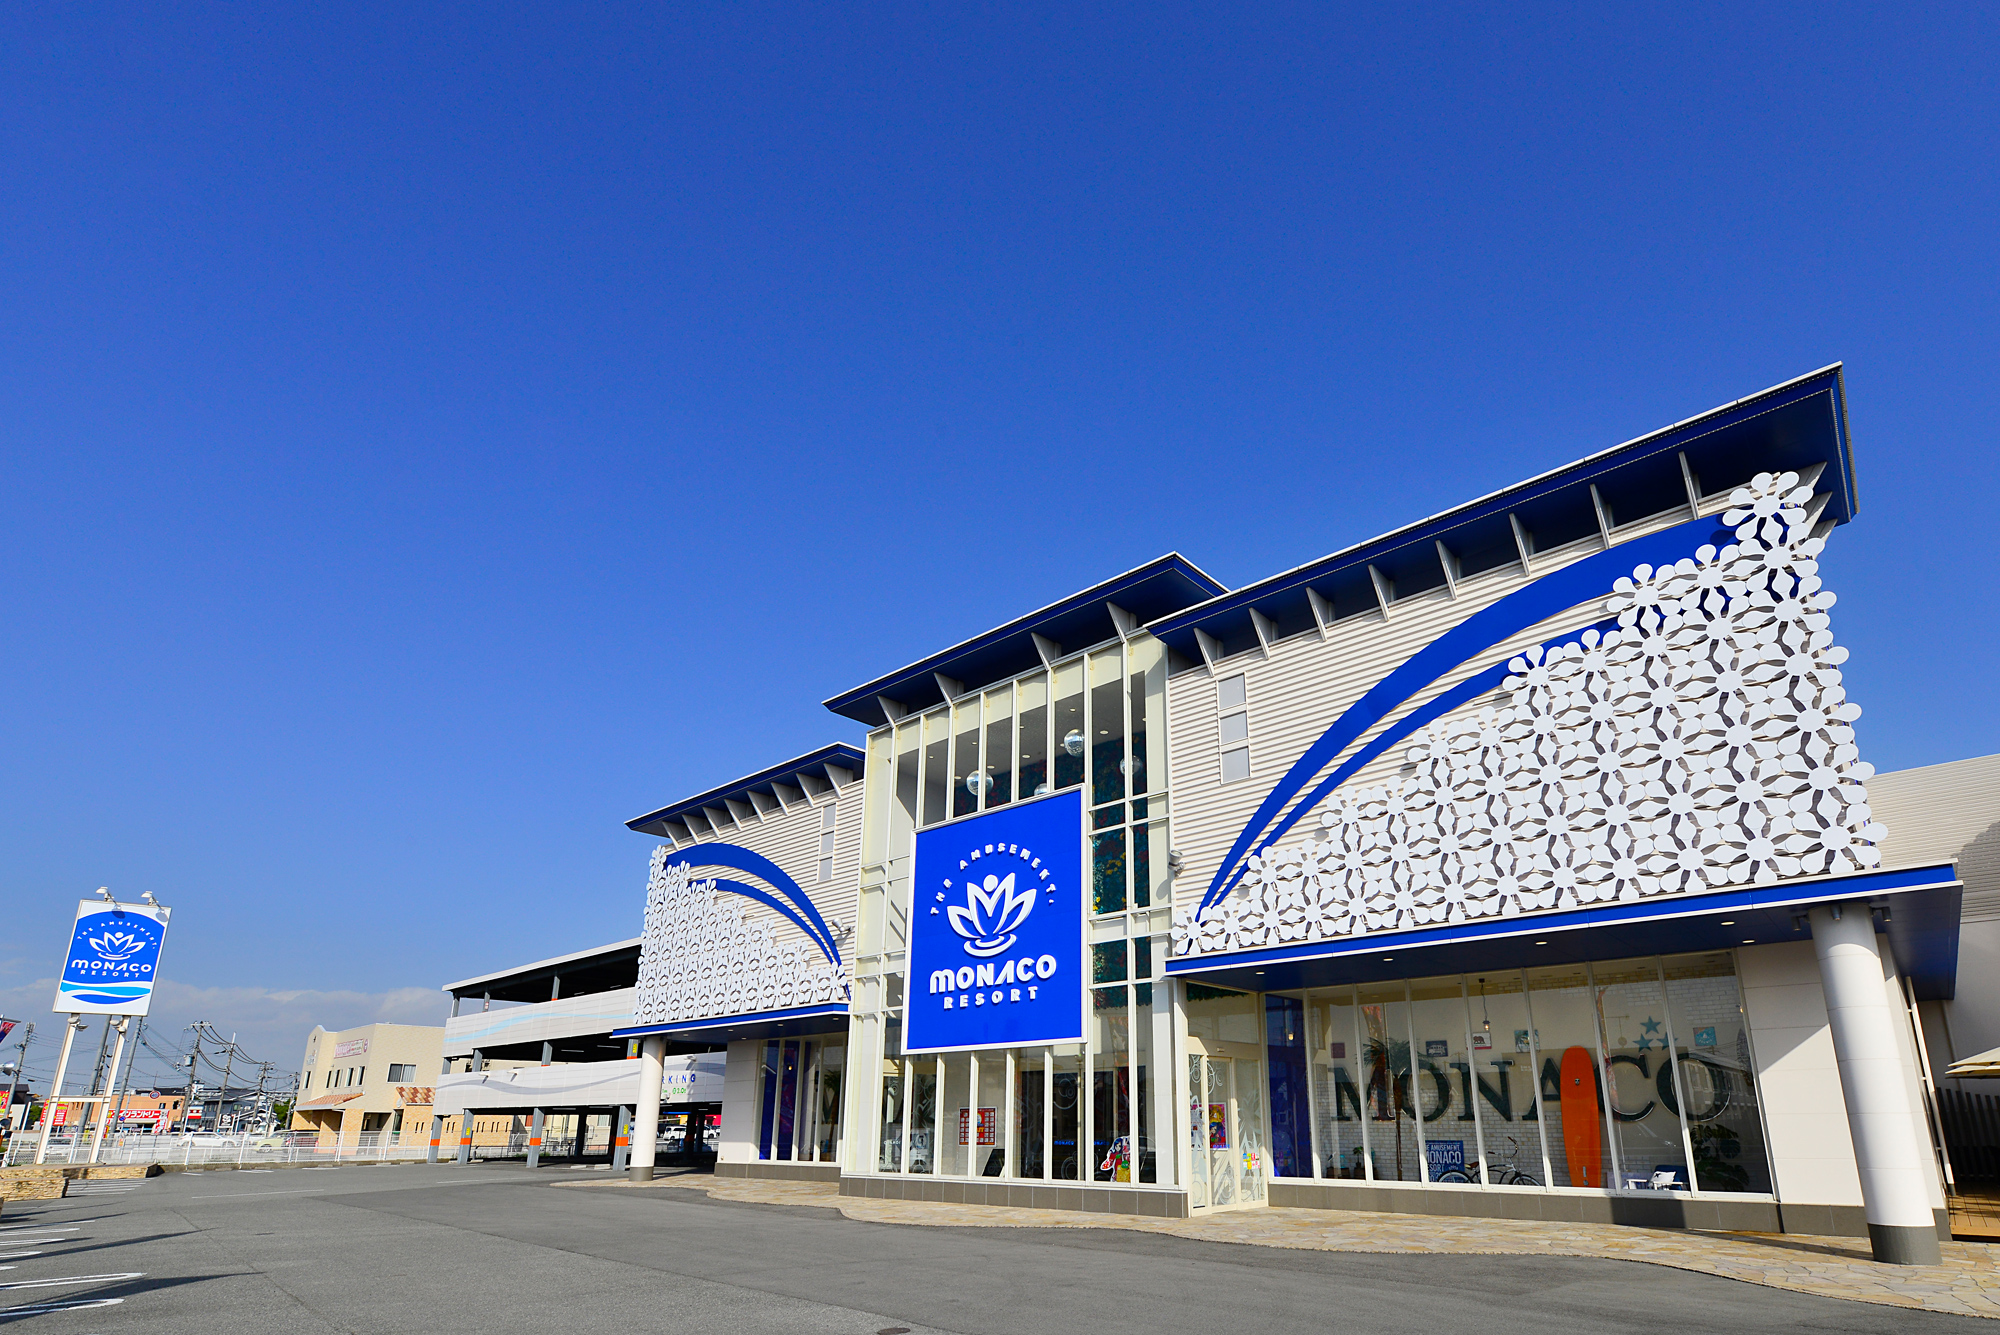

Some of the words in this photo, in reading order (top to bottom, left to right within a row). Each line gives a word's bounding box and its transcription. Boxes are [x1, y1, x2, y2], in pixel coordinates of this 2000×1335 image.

[930, 878, 953, 917] THE
[71, 959, 152, 973] MONACO
[80, 970, 140, 978] RESORT
[929, 954, 1057, 995] MONACO
[943, 986, 1039, 1010] RESORT
